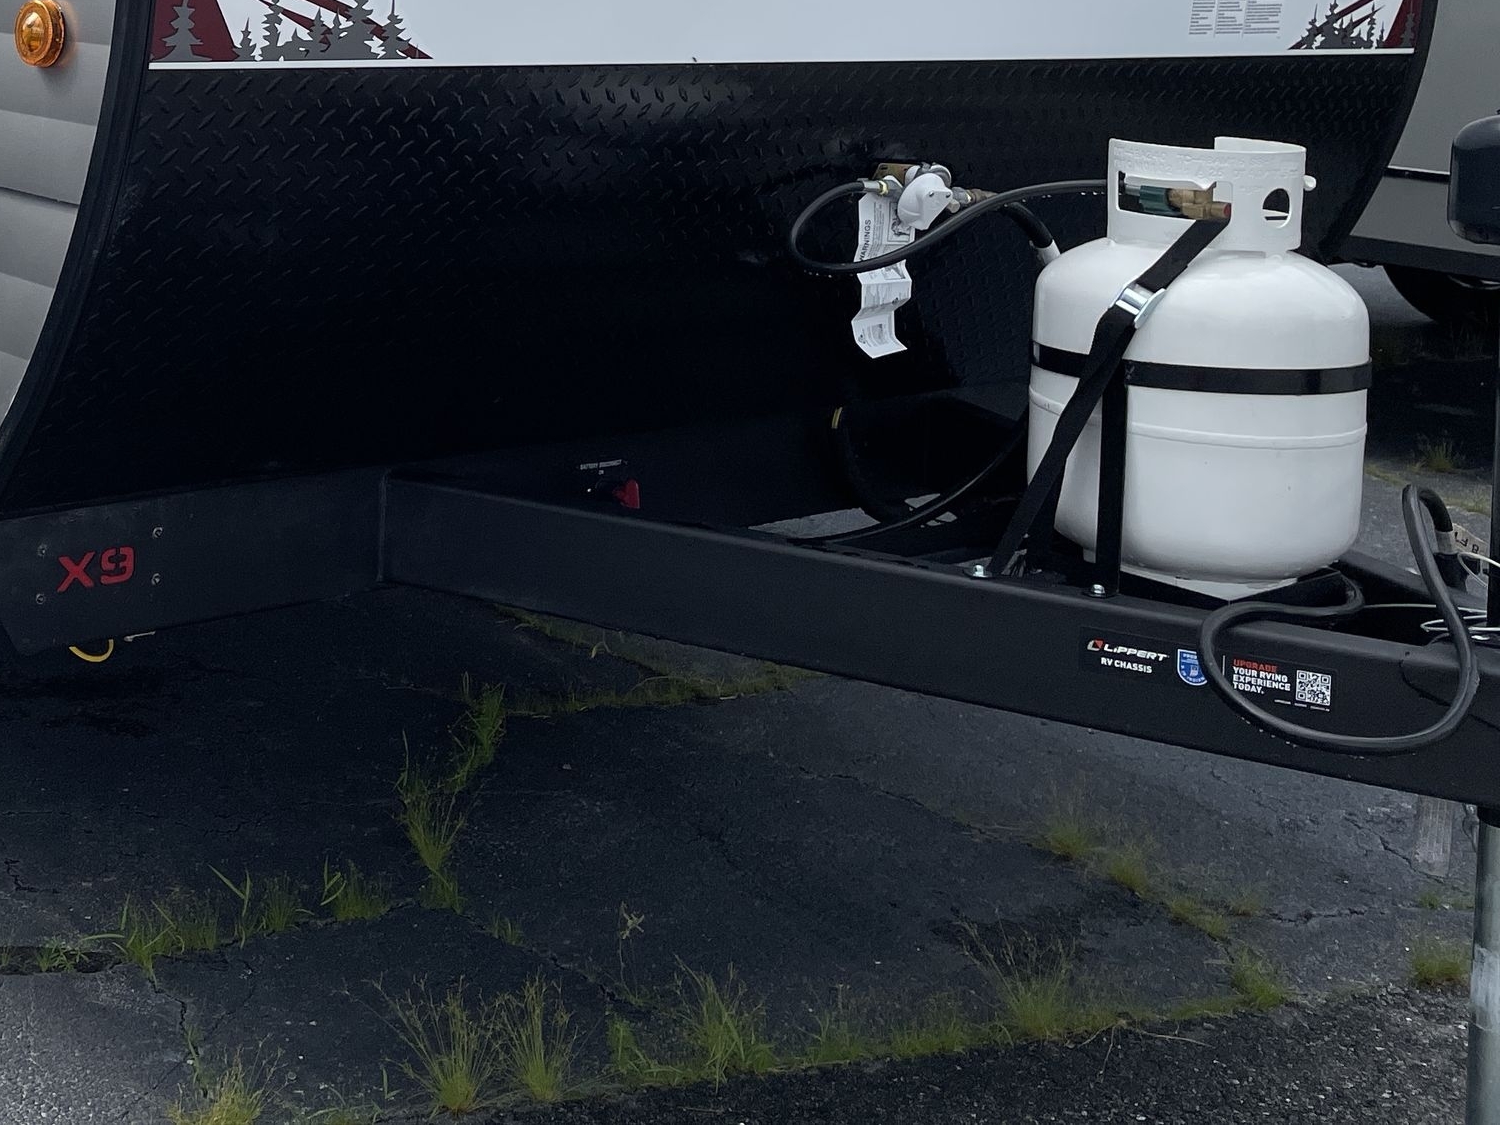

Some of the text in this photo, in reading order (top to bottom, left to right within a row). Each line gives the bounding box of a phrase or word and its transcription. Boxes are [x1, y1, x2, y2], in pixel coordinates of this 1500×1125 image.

[56, 546, 136, 593] X9
[1100, 657, 1153, 674] RV CHASSIS
[1233, 659, 1277, 672] UPGRADE
[1232, 666, 1288, 683] YOUR RVING
[1232, 674, 1291, 691] EXPERIENCE
[1232, 681, 1265, 695] TODAY.
